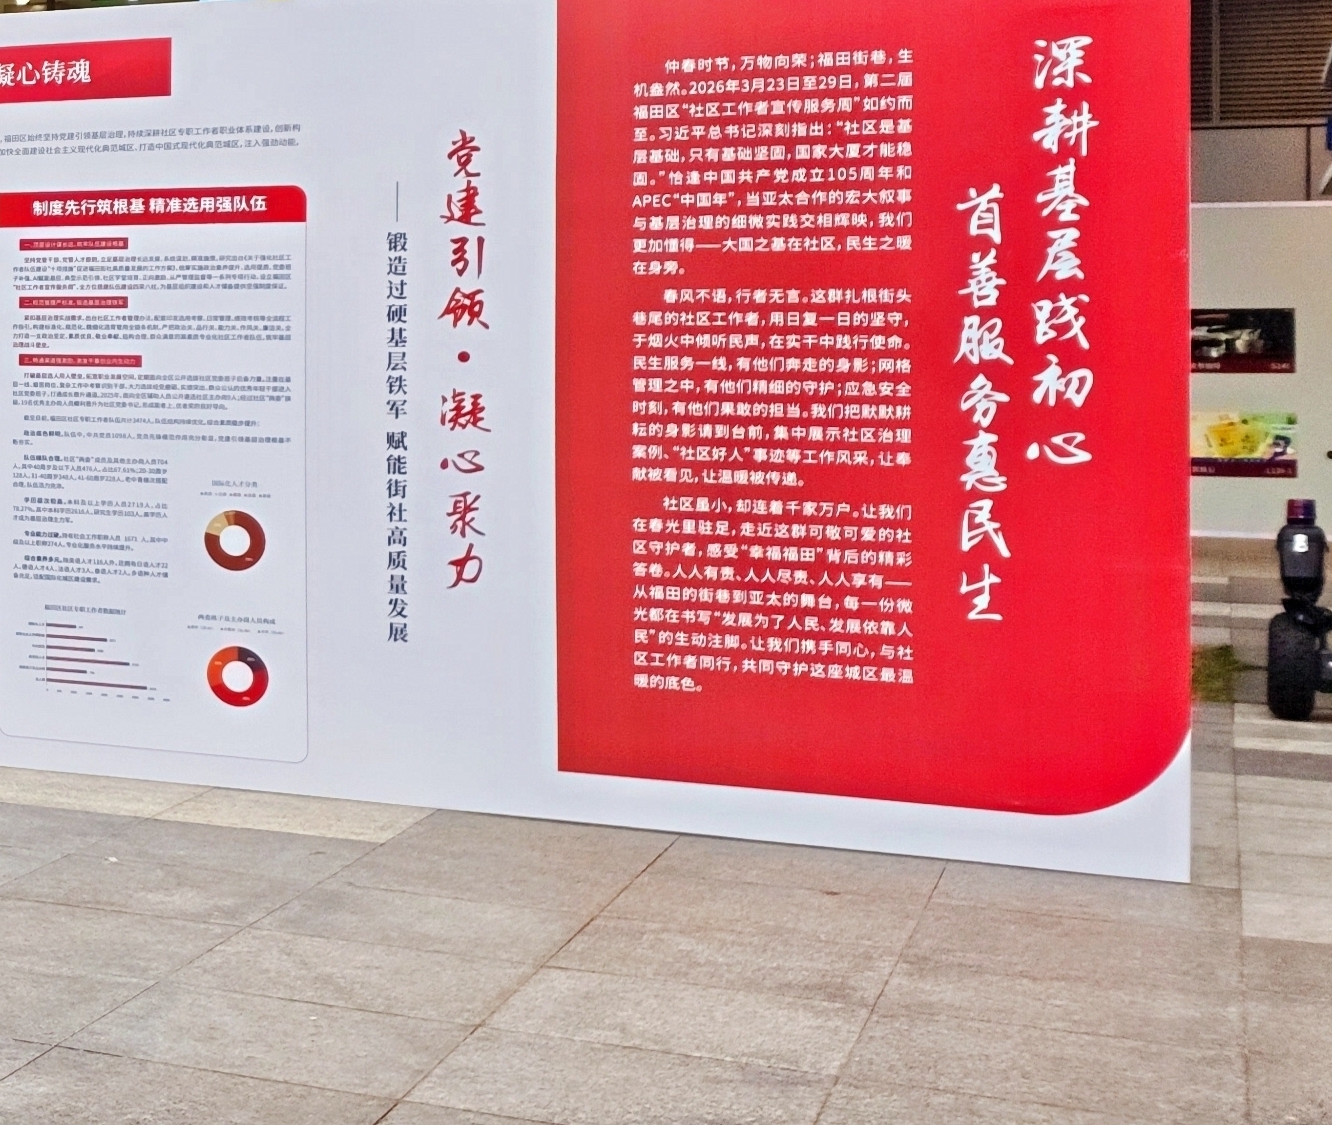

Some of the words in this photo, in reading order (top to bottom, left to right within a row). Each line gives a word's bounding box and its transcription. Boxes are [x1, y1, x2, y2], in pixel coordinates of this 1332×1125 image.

[32, 198, 145, 216] 制度先行筑根基
[149, 196, 267, 214] 精准选用强队伍
[633, 260, 685, 276] 在身旁。
[1027, 35, 1100, 465] 深耕基层践初心
[438, 128, 492, 590] 党建引领·凝心聚力
[954, 183, 1015, 621] 首善服务惠民生
[385, 430, 409, 644] 赋能街社高质量发展
[634, 674, 702, 694] 暖的底色。
